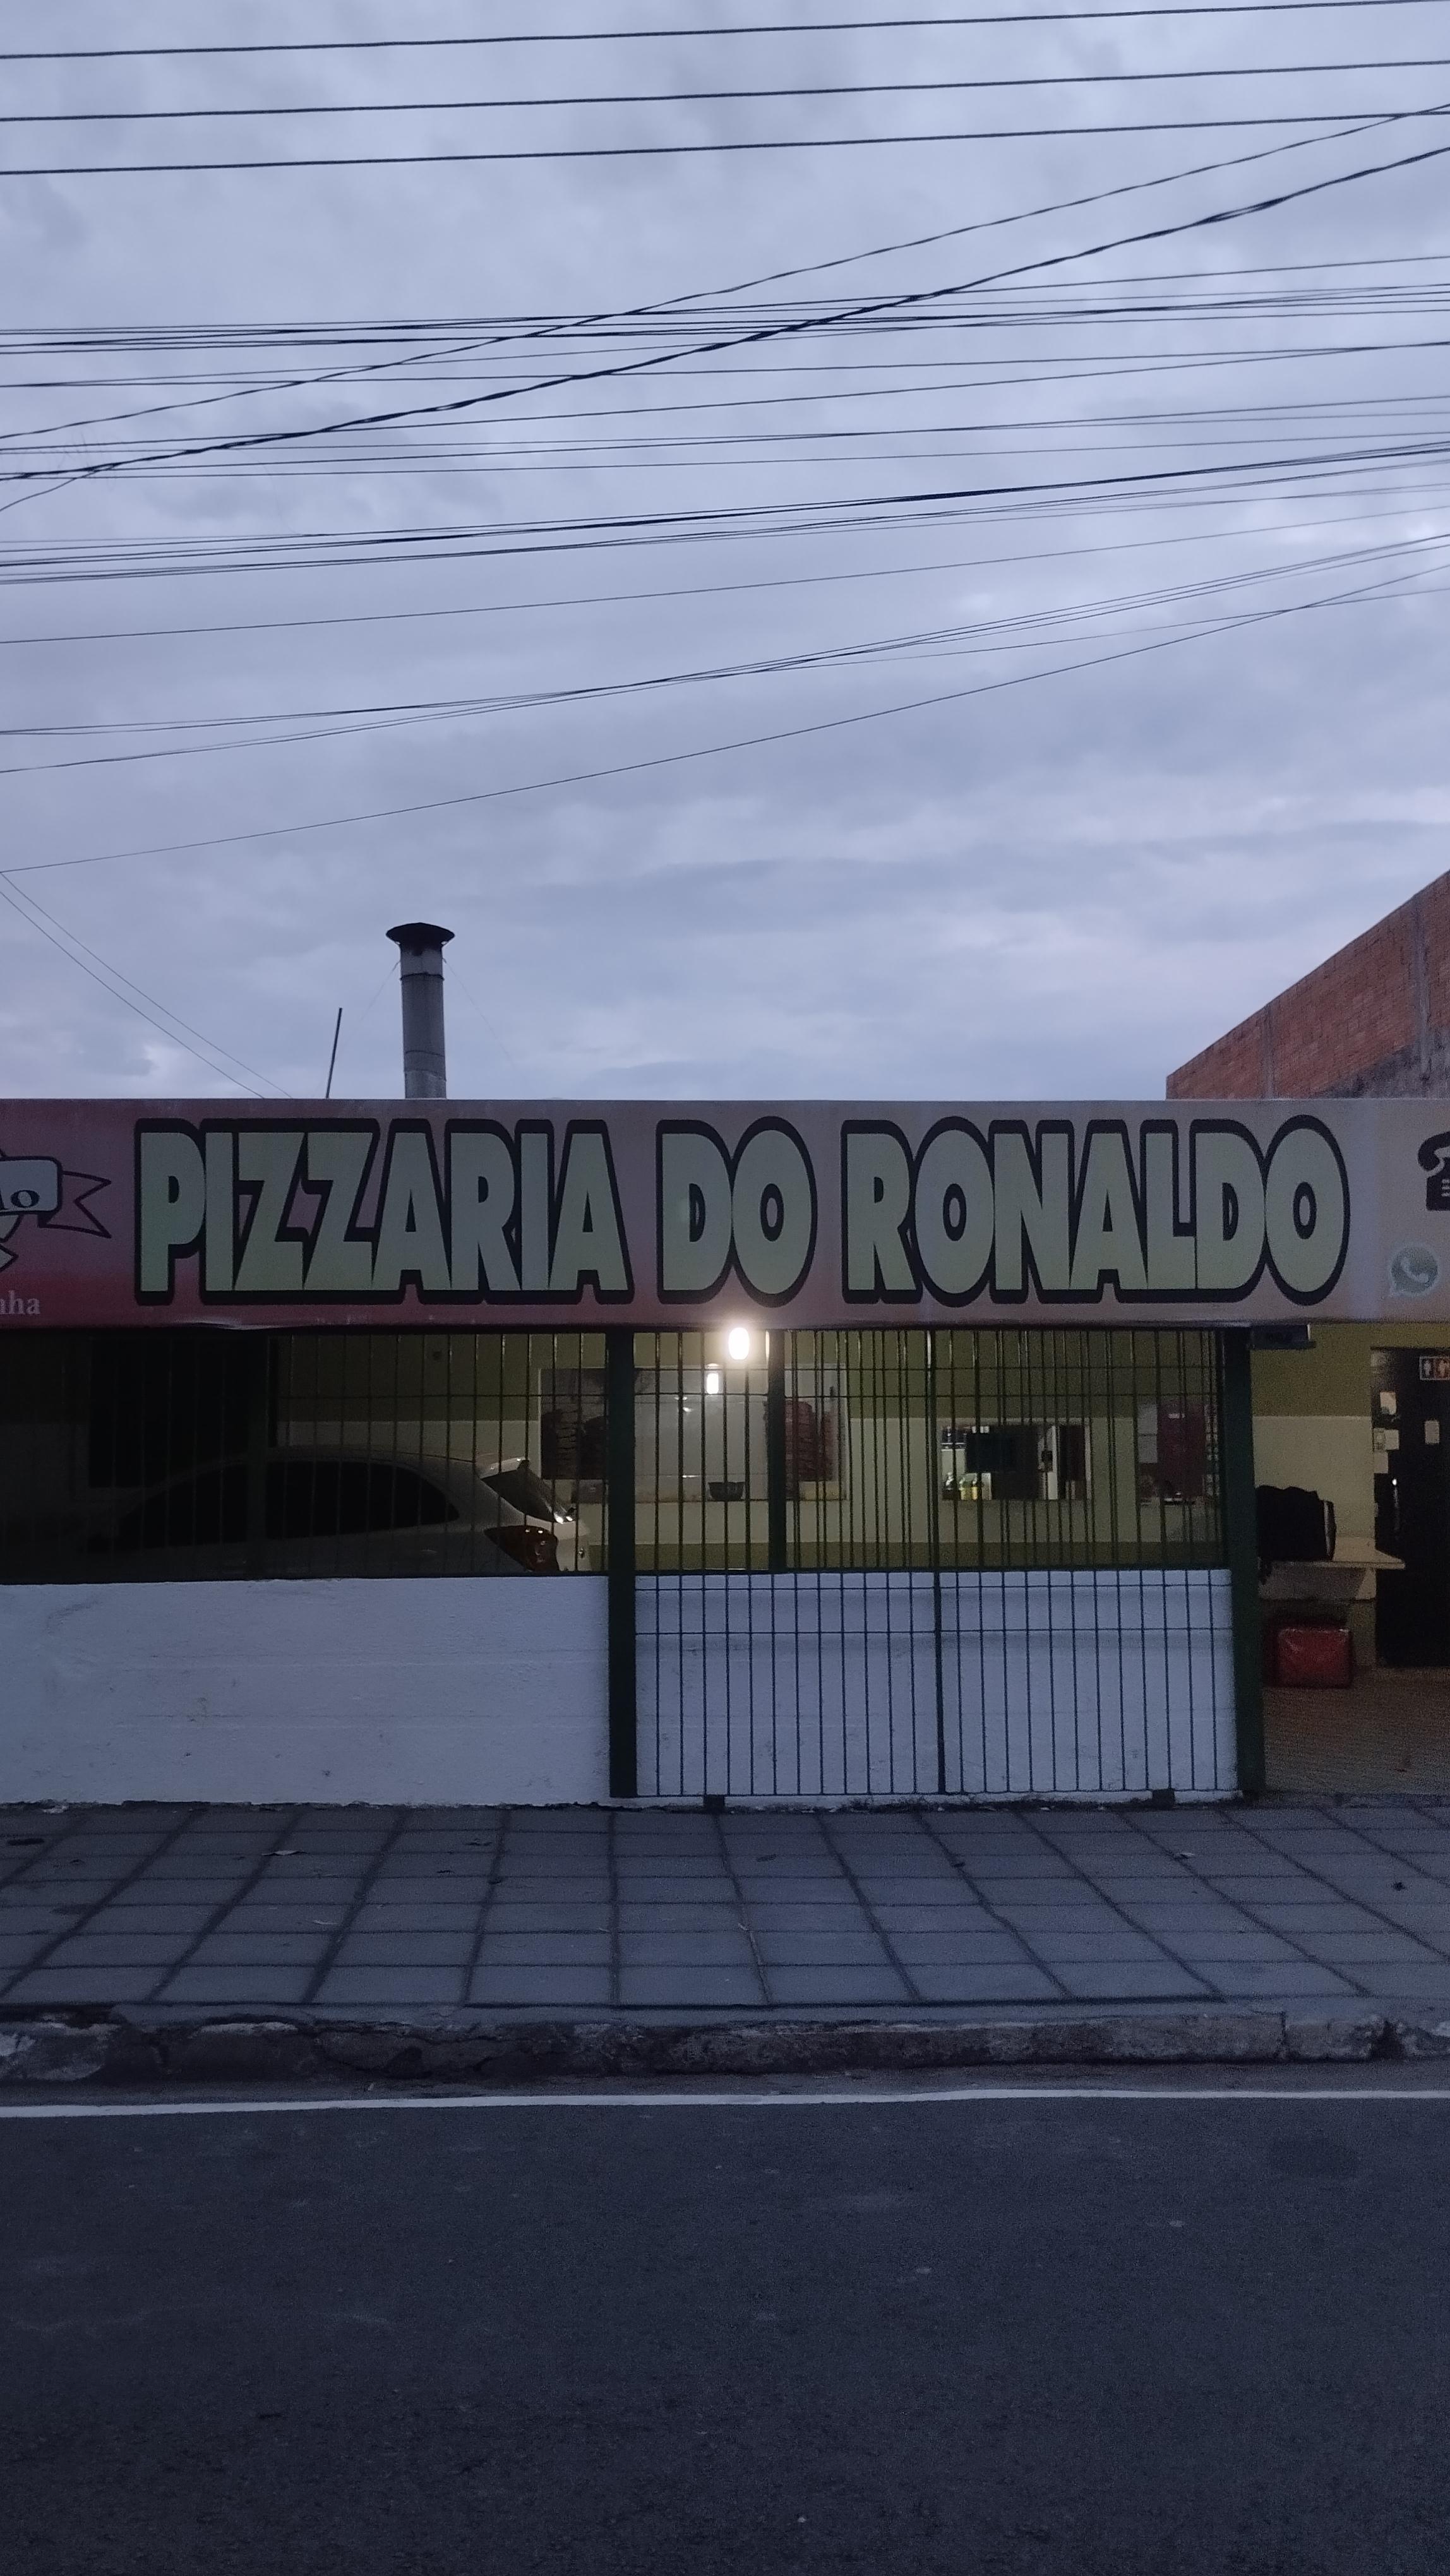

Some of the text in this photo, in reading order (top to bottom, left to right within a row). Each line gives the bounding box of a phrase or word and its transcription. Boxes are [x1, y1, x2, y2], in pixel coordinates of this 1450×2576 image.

[135, 1115, 1351, 1308] PIZZARIA DO RONALDO
